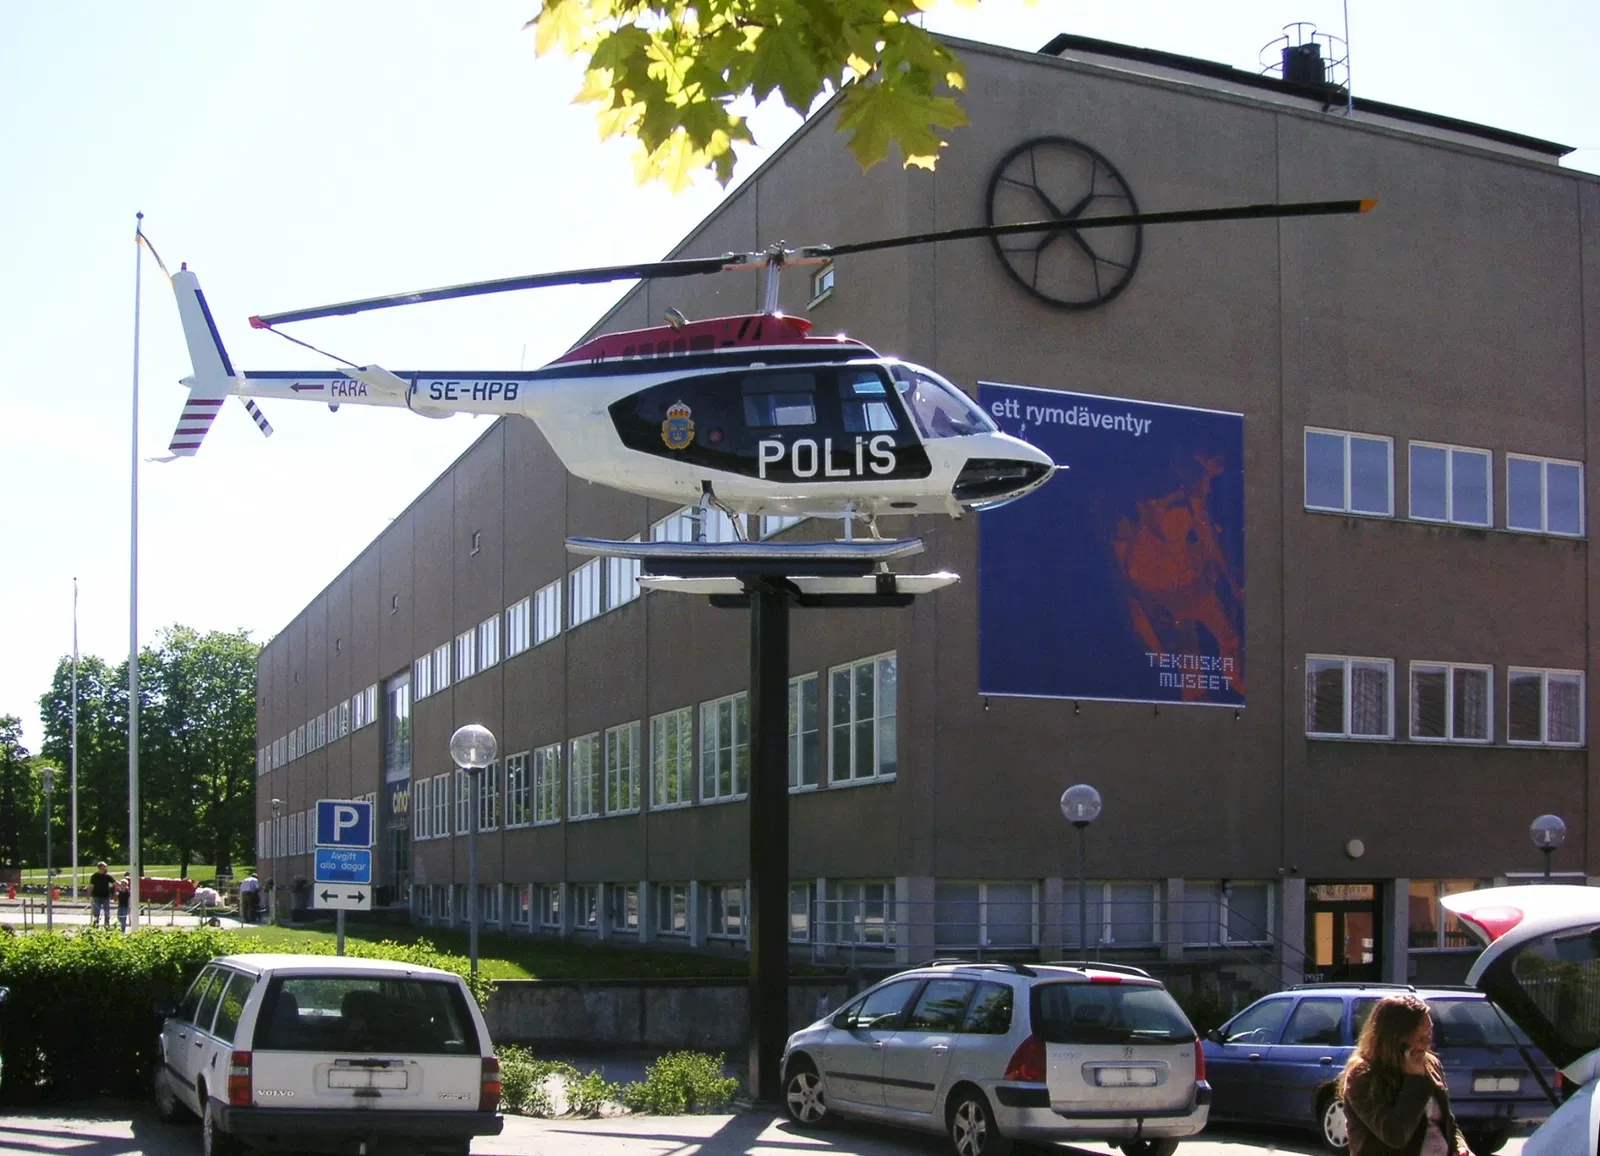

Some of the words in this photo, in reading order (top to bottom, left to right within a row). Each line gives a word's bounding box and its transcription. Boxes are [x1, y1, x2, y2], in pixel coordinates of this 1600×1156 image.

[331, 380, 367, 397] FARA
[429, 380, 519, 401] SE-HPB
[991, 398, 1020, 419] ett
[1026, 405, 1152, 437] rymdäventyr
[758, 434, 897, 479] POLIS
[1145, 652, 1233, 672] TEKNISKA
[1160, 672, 1233, 690] MUSEET
[333, 805, 359, 841] P
[320, 861, 336, 869] alla
[341, 862, 366, 871] dagar
[330, 851, 357, 862] Avgift
[257, 1089, 295, 1097] VOLVO
